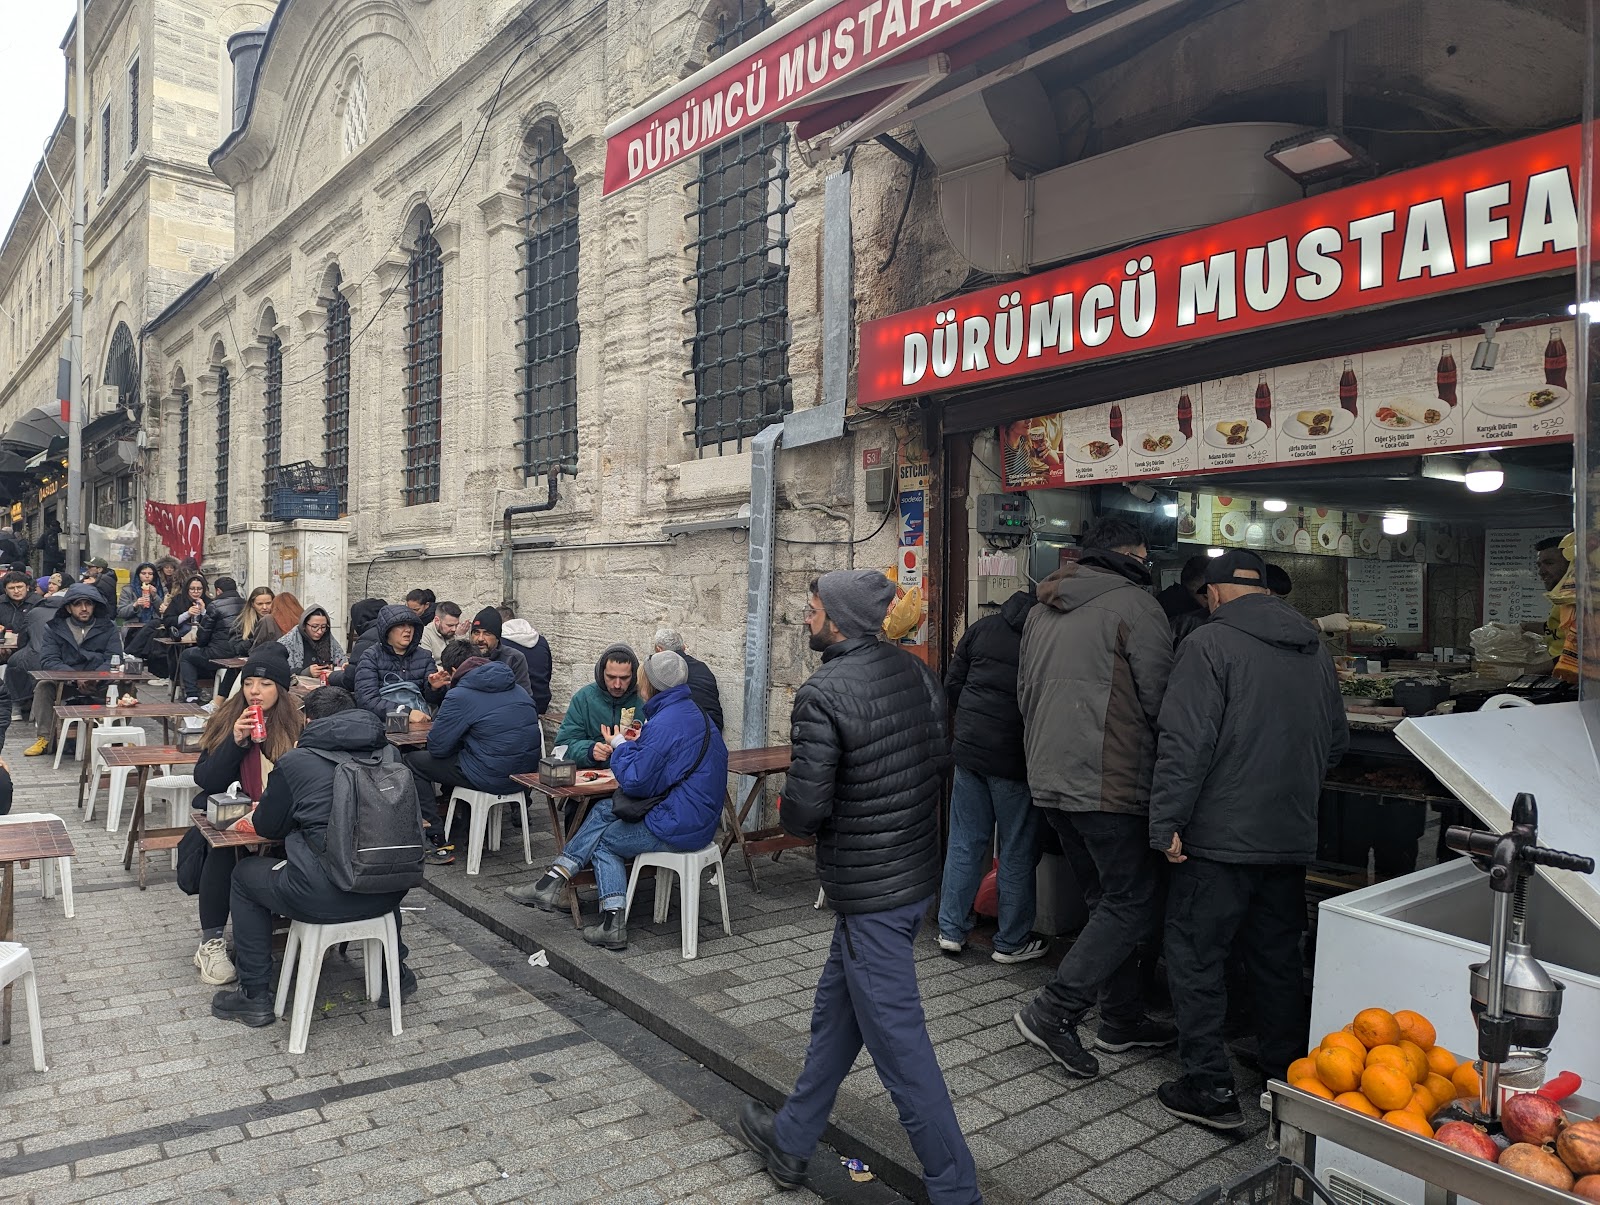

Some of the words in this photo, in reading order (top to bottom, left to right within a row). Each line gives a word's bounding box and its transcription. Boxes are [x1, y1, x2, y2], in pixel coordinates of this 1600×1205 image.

[627, 60, 767, 181] DÜRÜMCÜ
[902, 255, 1157, 386] DÜRÜMCÜ
[1177, 166, 1578, 327] MUSTAFA
[1476, 423, 1497, 433] Karışık
[1498, 422, 1518, 431] Dürüm
[1374, 435, 1388, 443] Ciğer
[1388, 434, 1397, 442] Şiş
[1397, 433, 1415, 441] Dürüm
[1486, 430, 1513, 439] Coca-Cola
[1385, 440, 1410, 448] Coca-Cola
[866, 453, 876, 463] 53
[1294, 450, 1317, 458] Coca-Cola
[901, 494, 922, 504] sodexo
